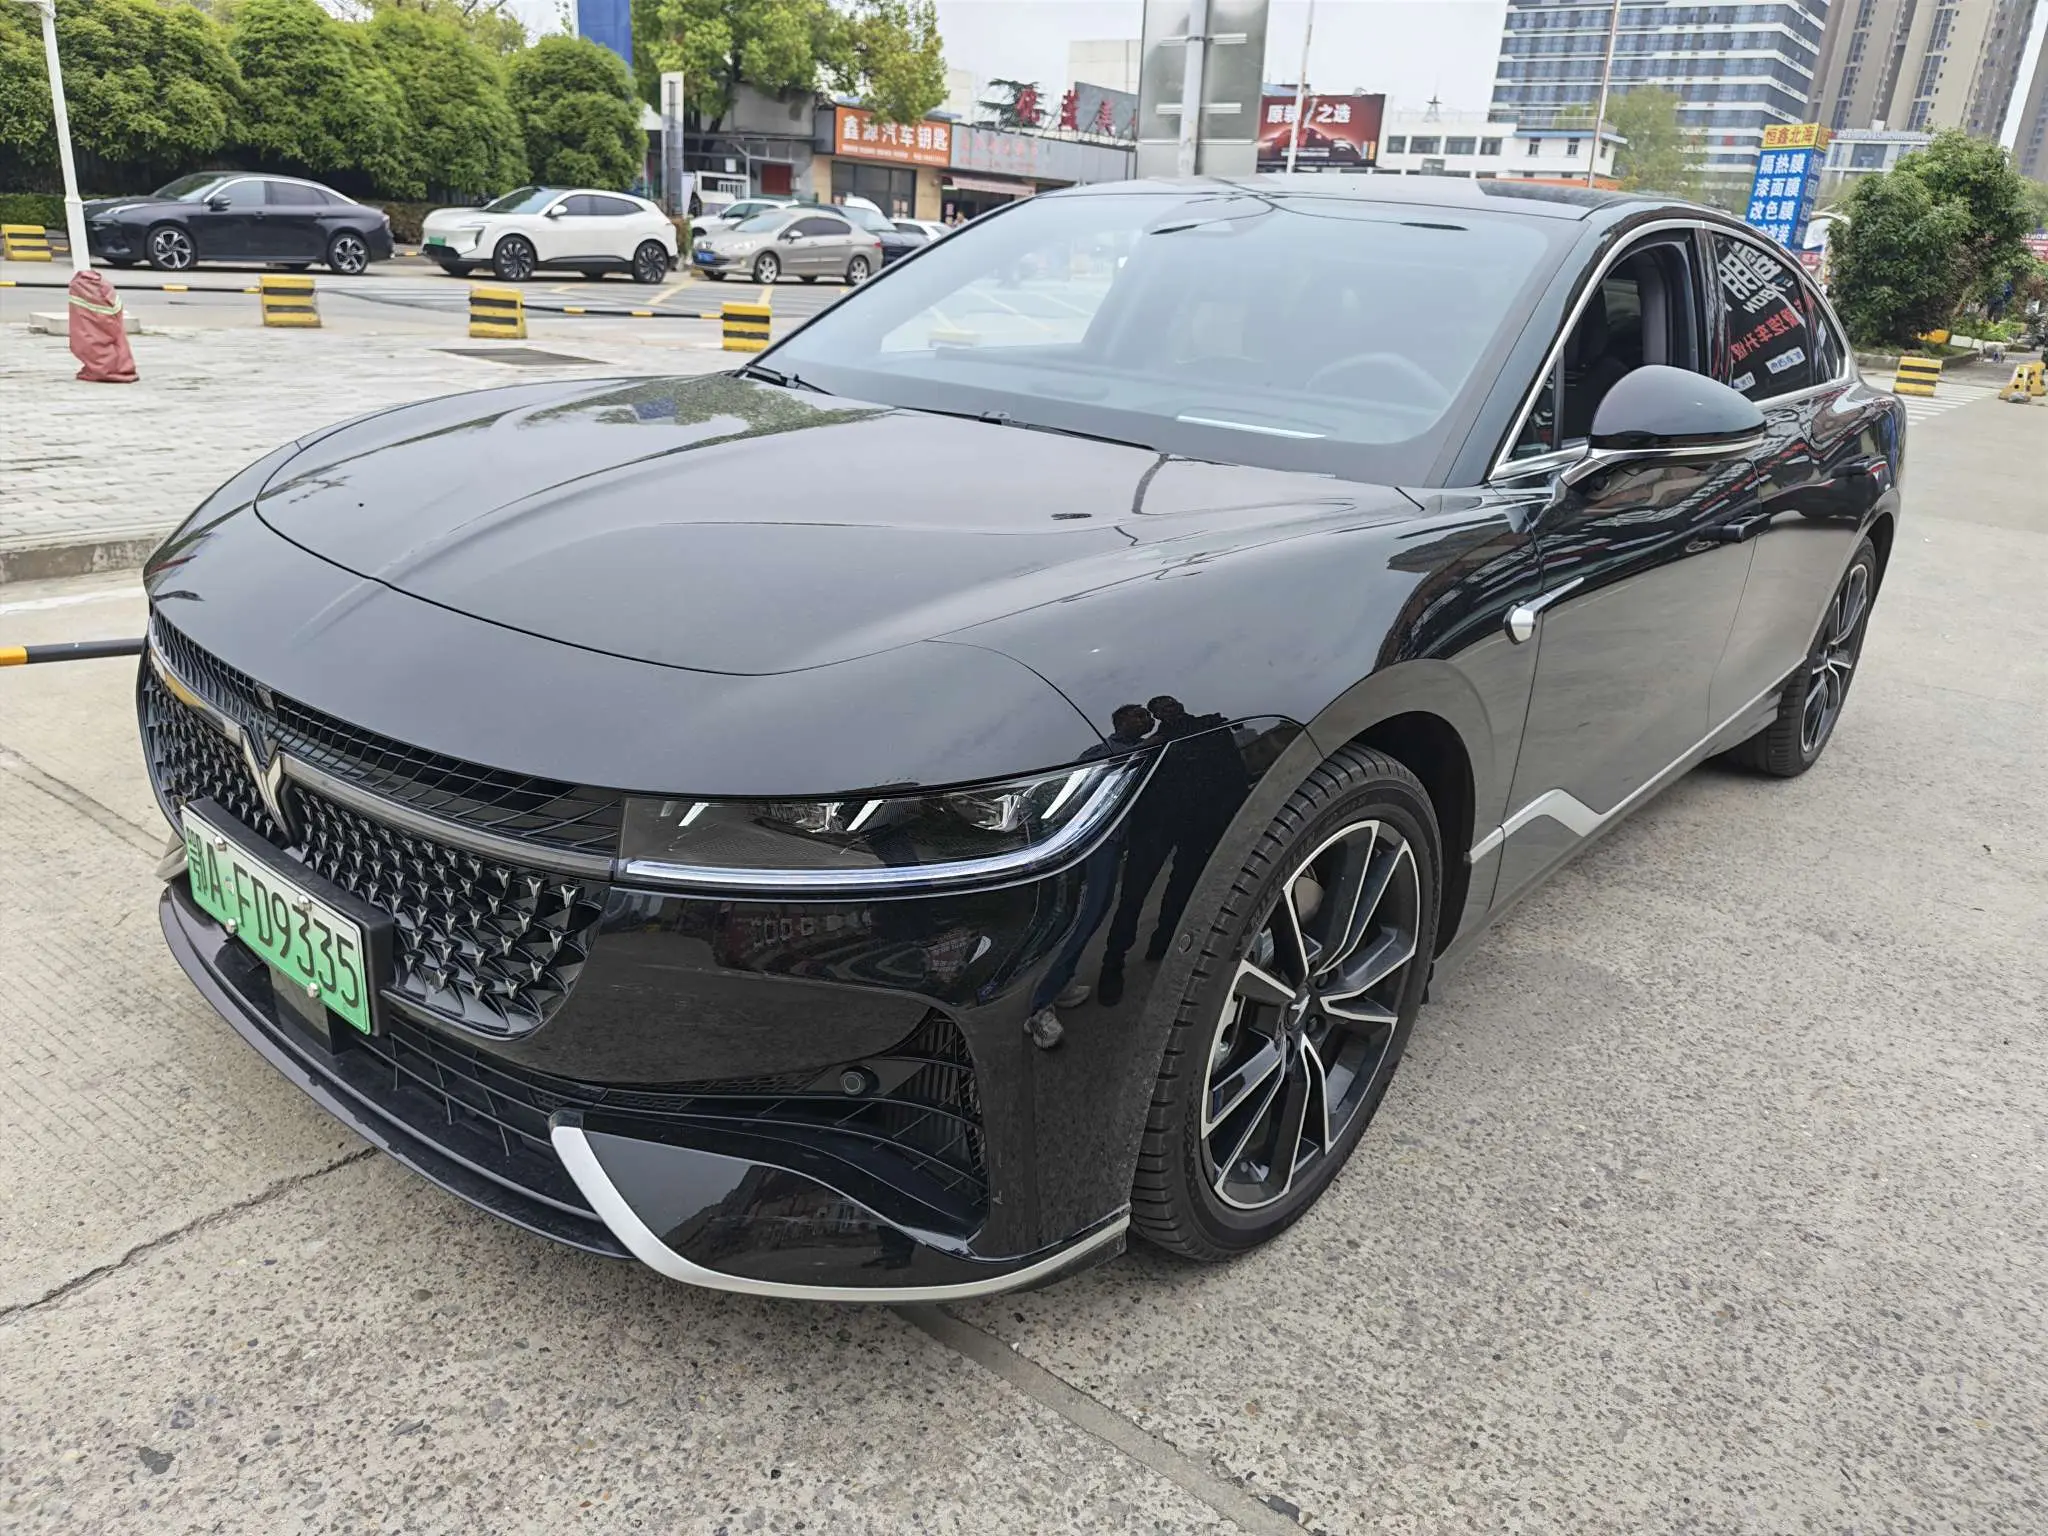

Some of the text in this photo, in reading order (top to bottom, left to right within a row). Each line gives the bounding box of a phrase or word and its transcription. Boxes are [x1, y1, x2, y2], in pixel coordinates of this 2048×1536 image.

[1759, 152, 1806, 174] 隔热膜
[1754, 176, 1801, 198] 漆面膜
[1749, 200, 1796, 221] 改色膜
